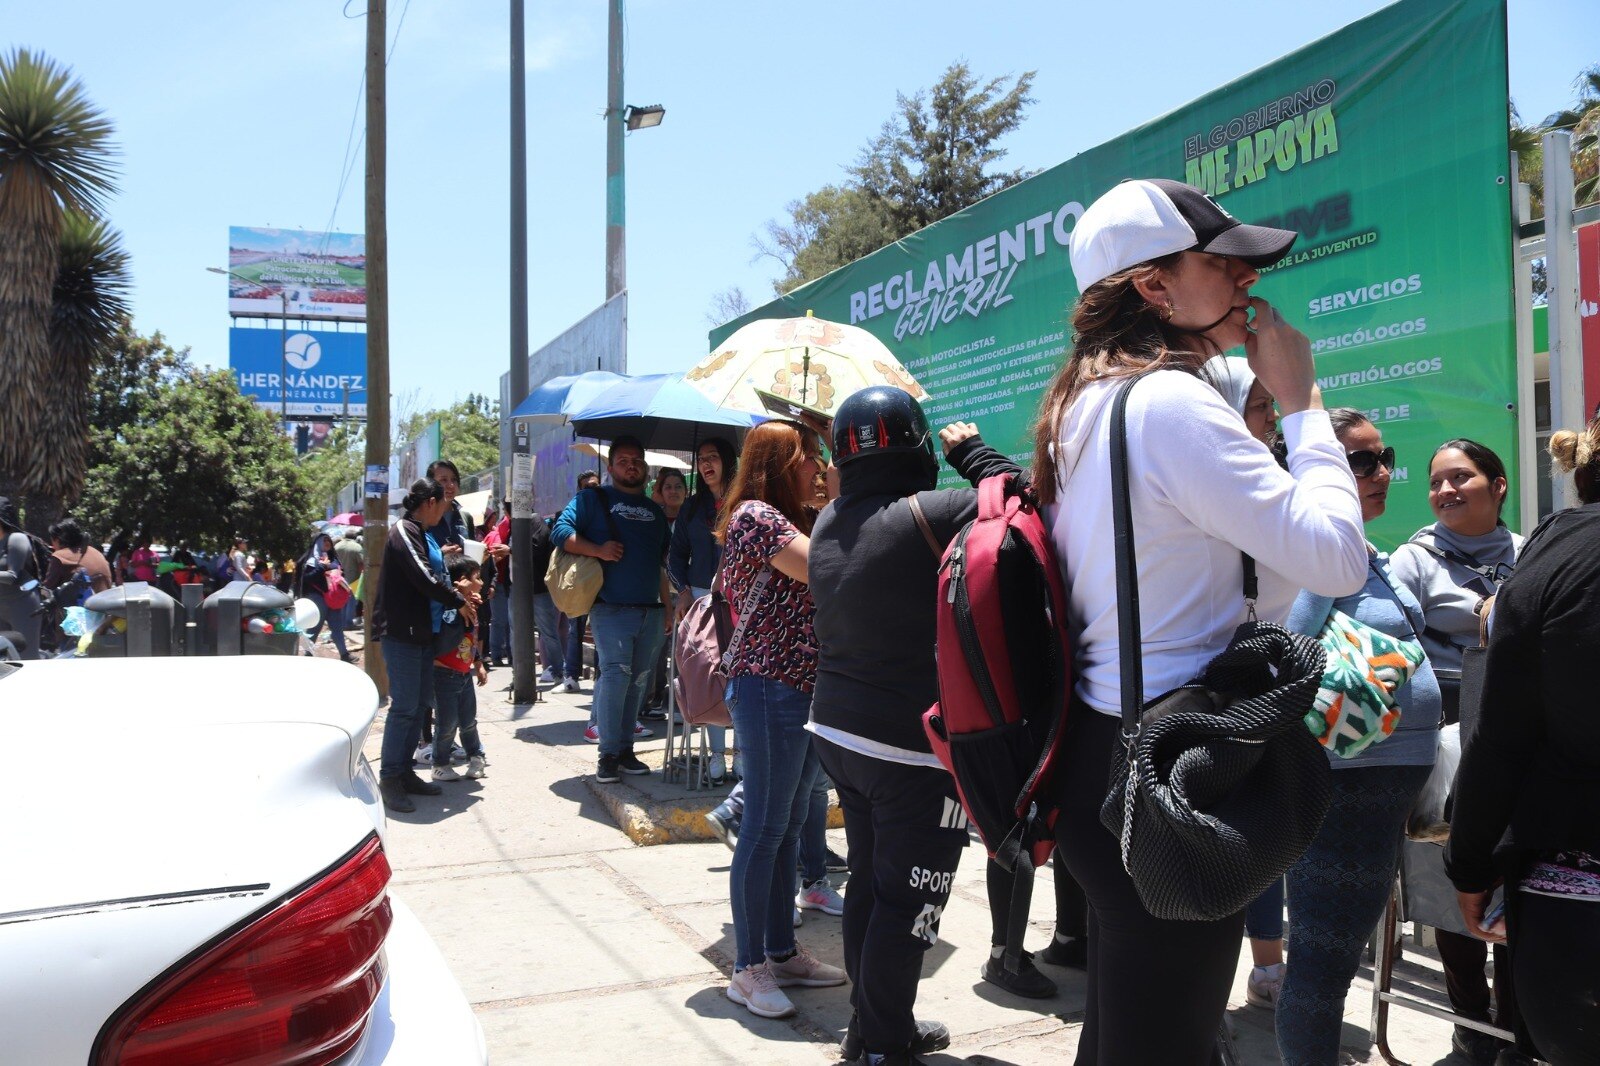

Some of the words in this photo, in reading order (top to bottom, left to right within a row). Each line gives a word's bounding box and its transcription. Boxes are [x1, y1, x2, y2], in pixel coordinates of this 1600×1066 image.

[1184, 134, 1208, 160] EL
[1207, 79, 1336, 148] GOBIERNO
[1185, 145, 1230, 197] ME
[1234, 103, 1338, 189] APOYA
[849, 201, 1086, 325] REGLAMENTO
[1277, 256, 1293, 269] DE
[1294, 251, 1310, 264] LA
[1311, 231, 1377, 259] JUVENTUD
[893, 262, 1019, 343] GENERAL
[1308, 274, 1422, 315] SERVICIOS
[909, 356, 930, 370] PARA
[930, 335, 996, 364] MOTOCICLISTAS
[927, 362, 957, 377] INGRESAR
[958, 359, 972, 368] CON
[973, 342, 1025, 365] MOTOCICLETAS
[1026, 339, 1037, 349] EN
[1037, 331, 1064, 345] ÁREAS
[933, 380, 941, 388] EL
[941, 363, 1002, 385] ESTACIONAMIENTO
[1003, 361, 1009, 369] Y
[1009, 351, 1043, 367] EXTREME
[1044, 345, 1066, 358] PARK
[240, 371, 363, 389] HERNÁNDEZ
[1000, 369, 1033, 384] ADEMÁS,
[1316, 357, 1443, 390] NUTRIÓLOGOS
[269, 390, 336, 399] FUNERALES
[932, 402, 953, 413] ZONAS
[954, 400, 964, 408] NO
[964, 388, 1014, 404] AUTORIZADAS.
[1385, 404, 1410, 420] DE
[934, 413, 970, 425] ORDENADO
[970, 408, 989, 418] PARA
[990, 401, 1015, 414] TODXS!
[742, 580, 764, 616] BIMBA
